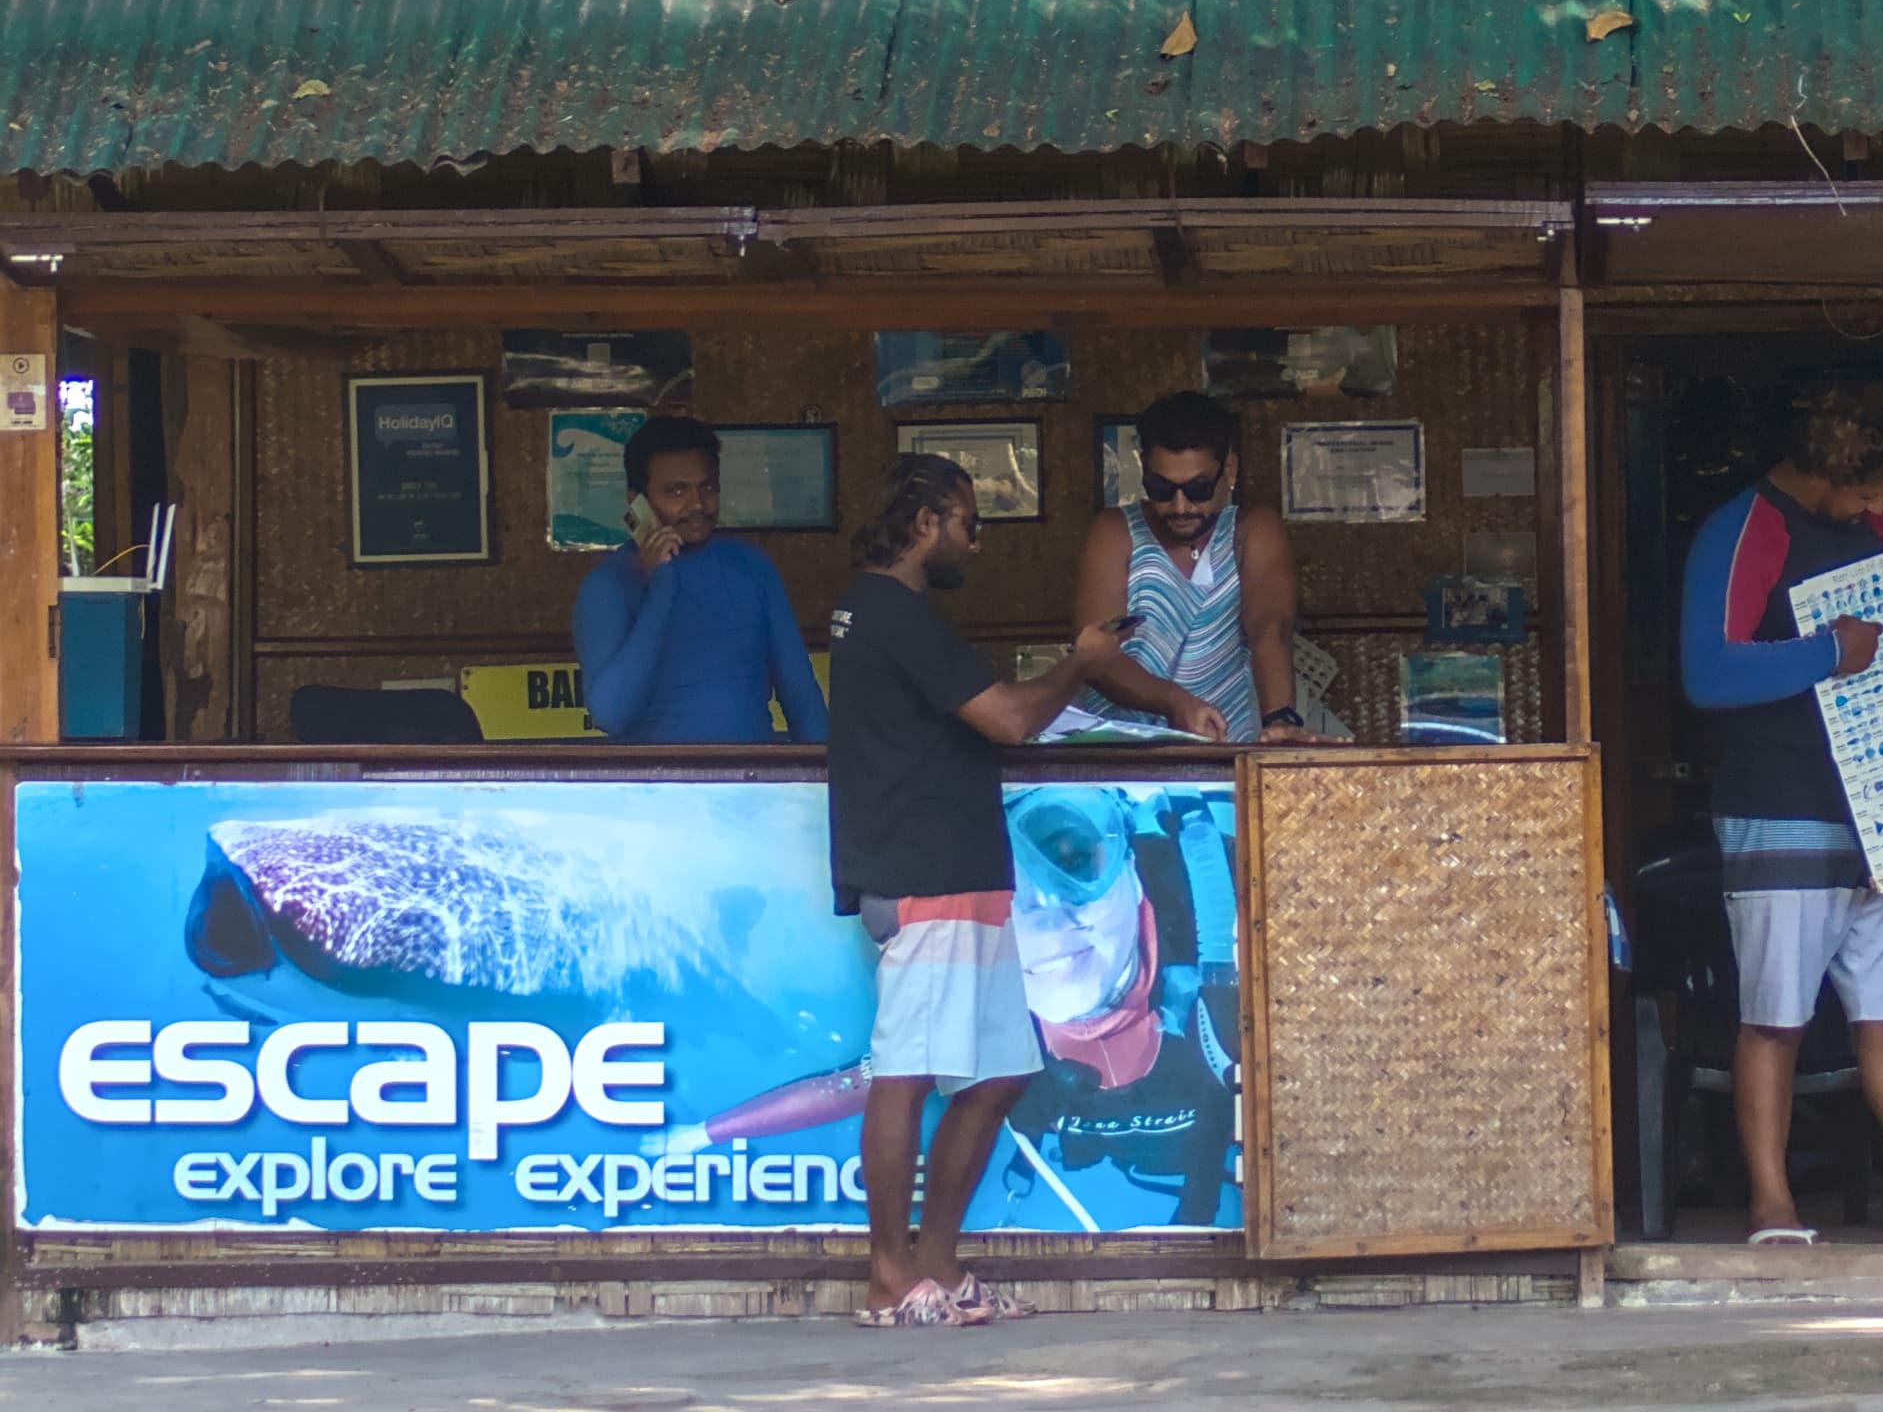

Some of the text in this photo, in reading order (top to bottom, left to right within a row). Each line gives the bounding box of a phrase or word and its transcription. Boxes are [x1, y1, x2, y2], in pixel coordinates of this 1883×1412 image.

[58, 1019, 666, 1162] escape
[173, 1136, 926, 1218] explore experienc
